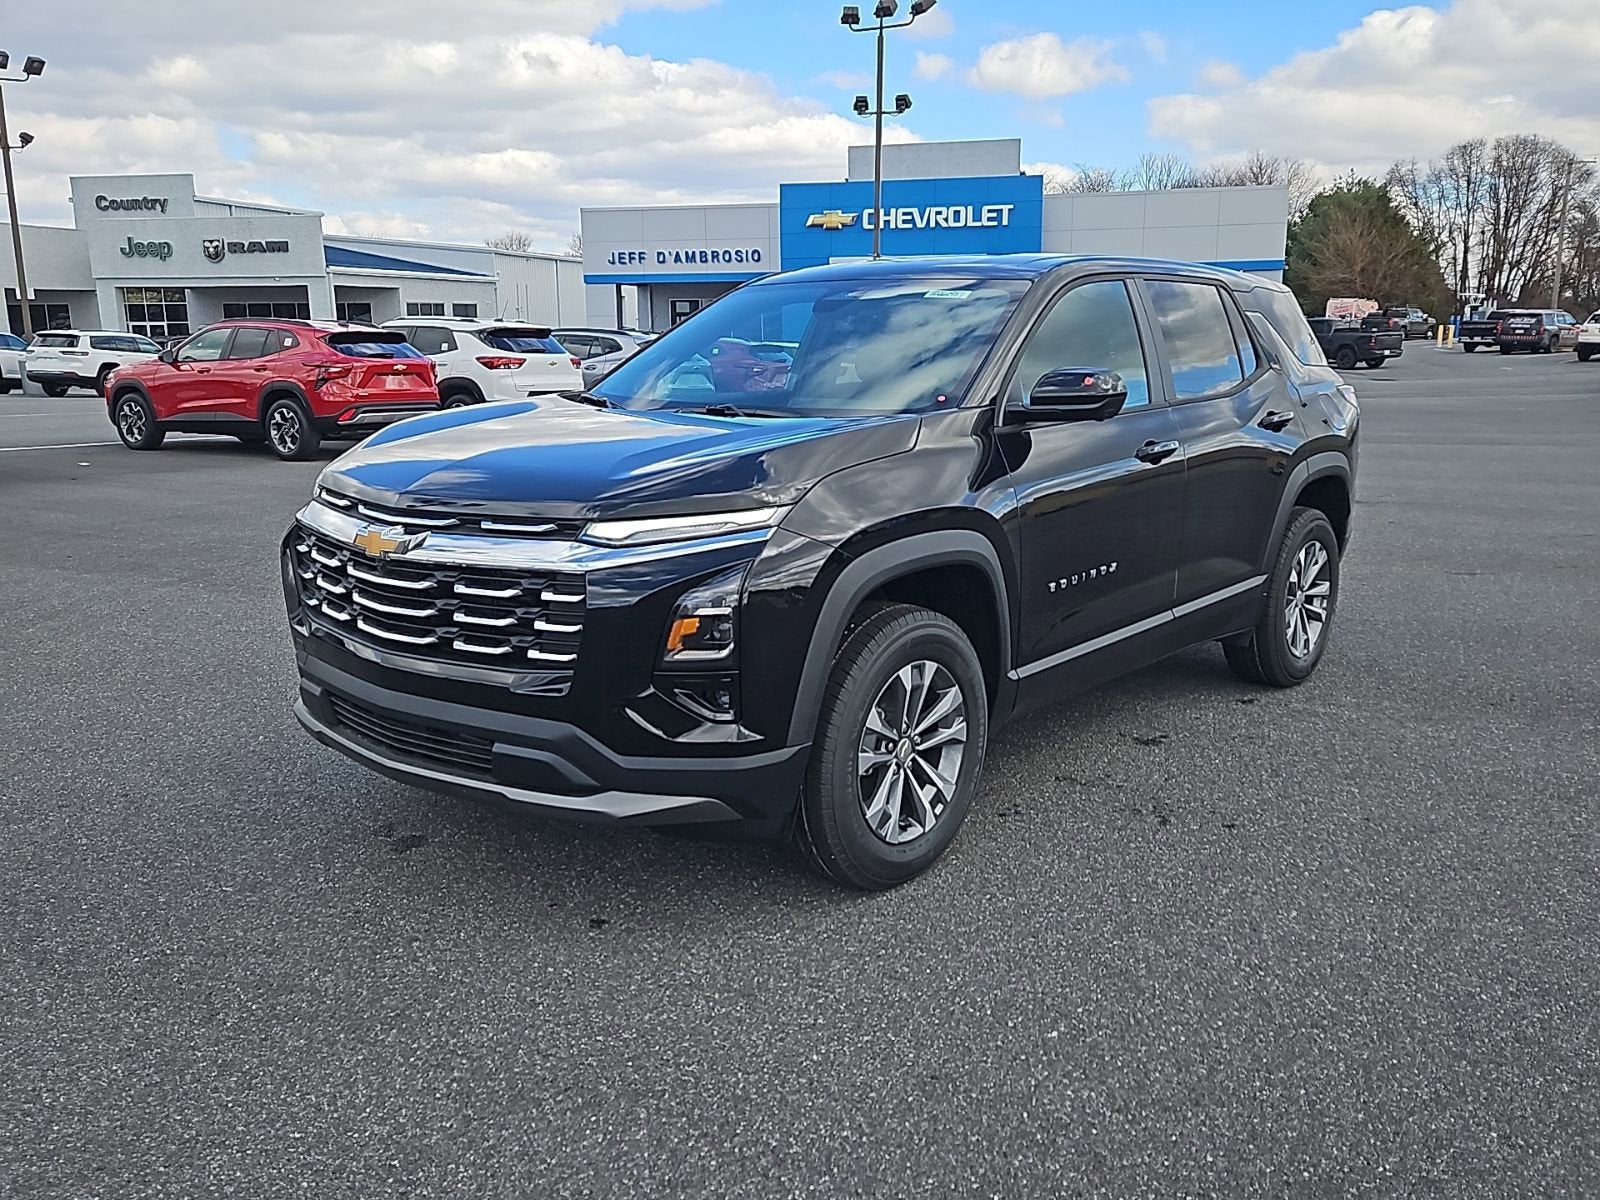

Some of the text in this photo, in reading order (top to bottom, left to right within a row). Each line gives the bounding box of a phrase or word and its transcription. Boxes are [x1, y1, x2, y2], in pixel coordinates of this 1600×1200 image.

[94, 194, 169, 214] Country
[861, 204, 1013, 230] CHEVROLET
[119, 236, 173, 261] Jeep
[227, 240, 289, 253] RAM
[607, 248, 762, 266] JEFF D'AMBROSIO
